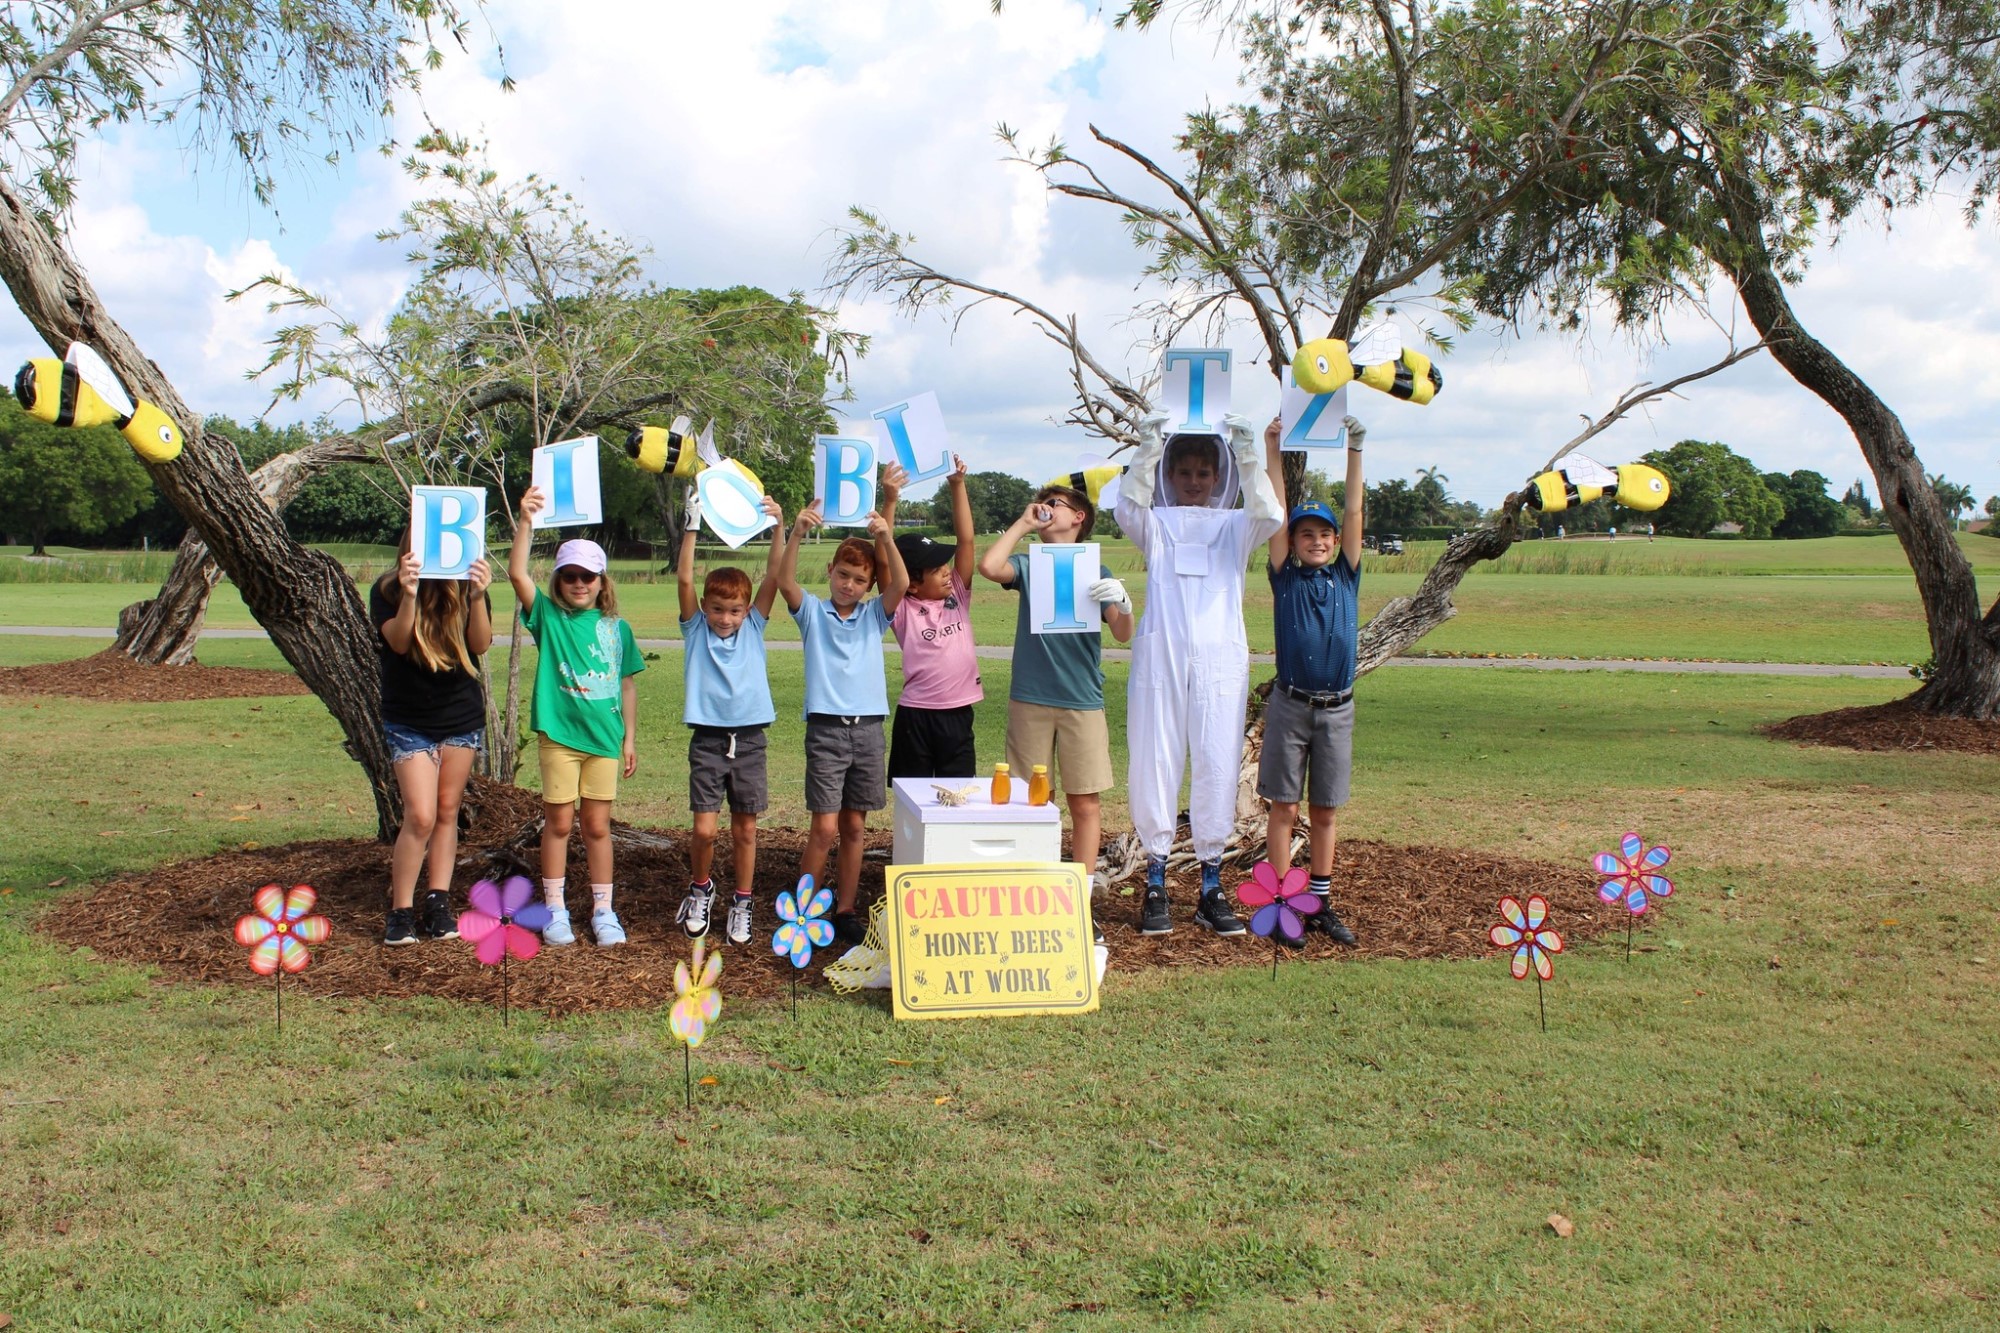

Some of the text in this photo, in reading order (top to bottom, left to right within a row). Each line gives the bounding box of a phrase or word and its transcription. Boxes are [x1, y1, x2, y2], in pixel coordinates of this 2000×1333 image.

[1166, 352, 1229, 431] T
[542, 442, 590, 527] I
[818, 437, 876, 523] B
[873, 402, 951, 489] L
[416, 489, 481, 575] B
[699, 470, 768, 536] O
[1041, 546, 1087, 629] I
[904, 885, 1074, 920] CAUTION
[924, 929, 1063, 957] HONEY BEES
[944, 968, 1052, 995] AT WORK
